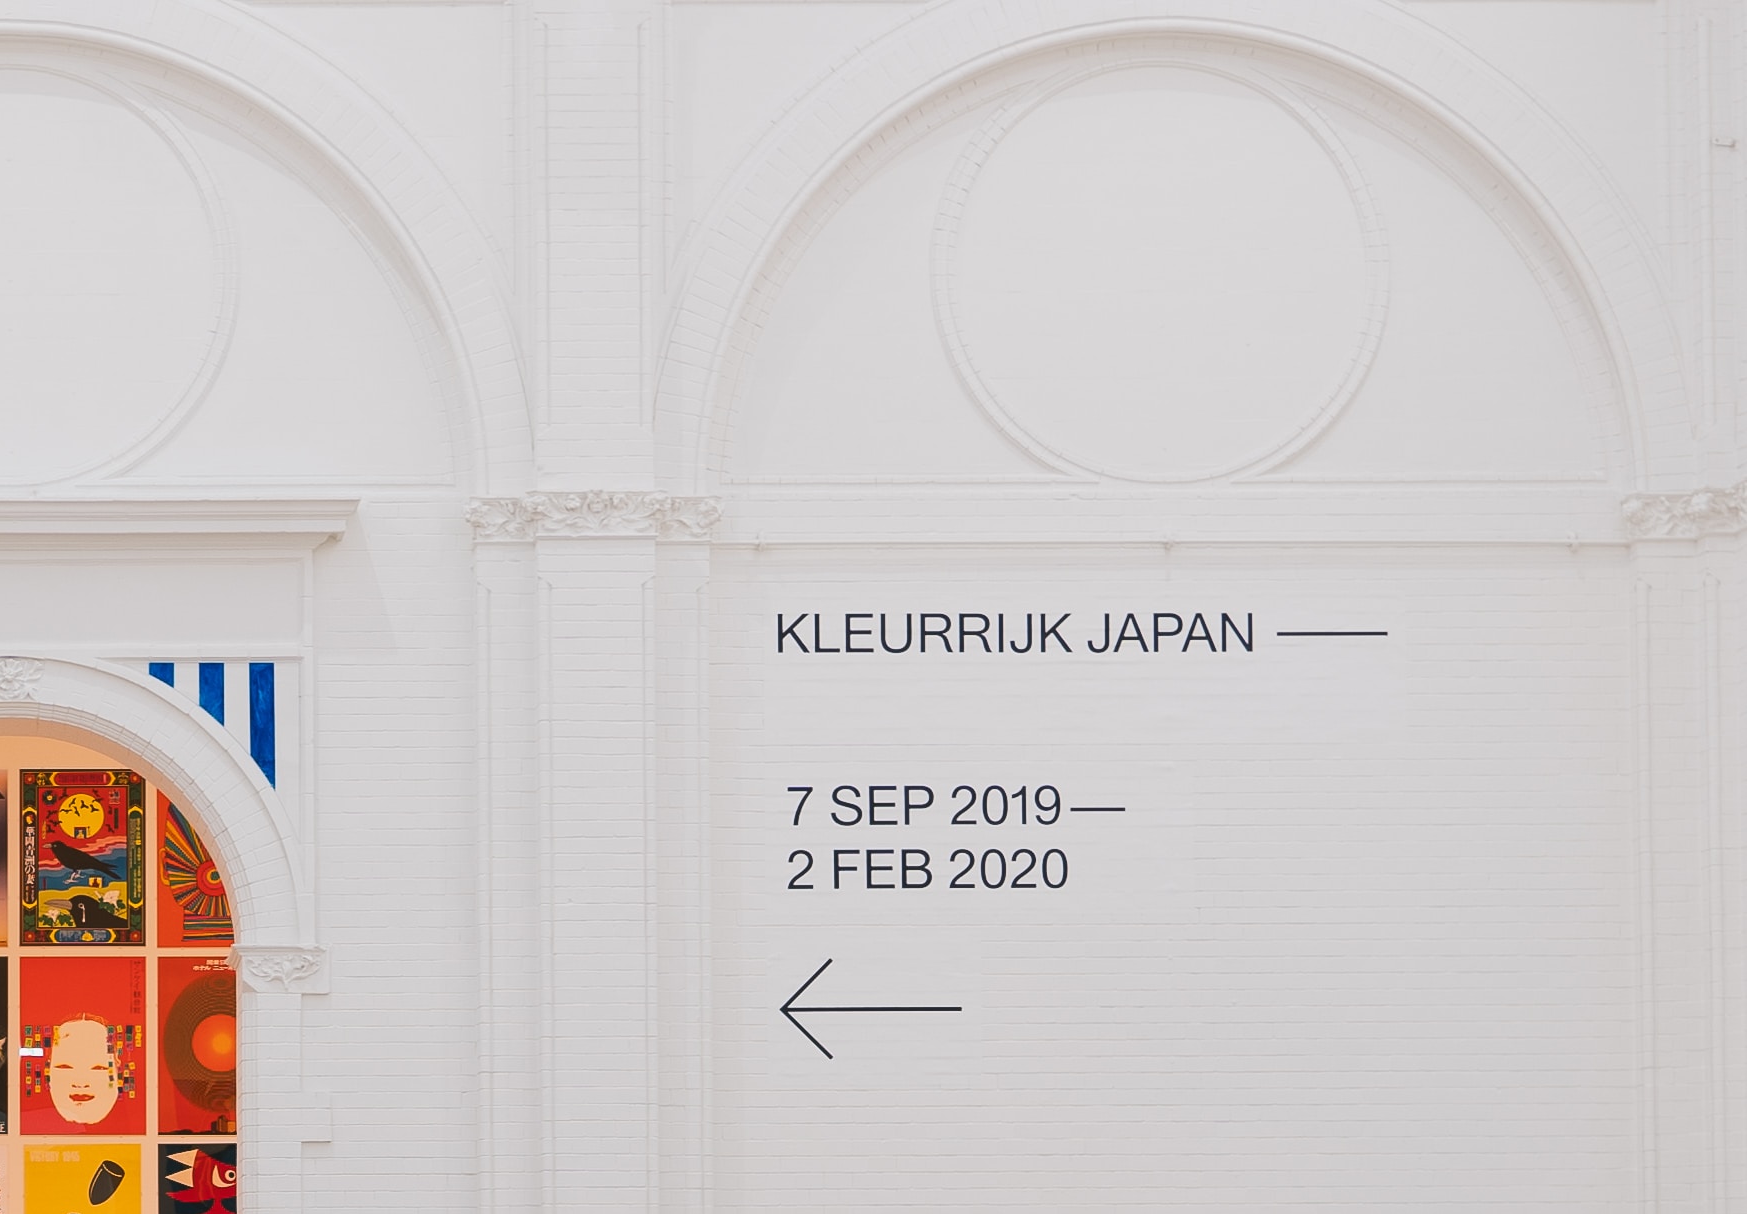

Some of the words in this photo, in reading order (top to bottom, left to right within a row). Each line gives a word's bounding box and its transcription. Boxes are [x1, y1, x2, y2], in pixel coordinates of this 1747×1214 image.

[778, 613, 1073, 654] KLEURRIJK
[1087, 613, 1253, 654] JAPAN
[787, 786, 814, 826] 7
[830, 785, 935, 827] SEP
[950, 785, 1061, 826] 2019
[787, 849, 814, 890] 2
[833, 848, 933, 890] FEB
[949, 848, 1068, 890] 2020
